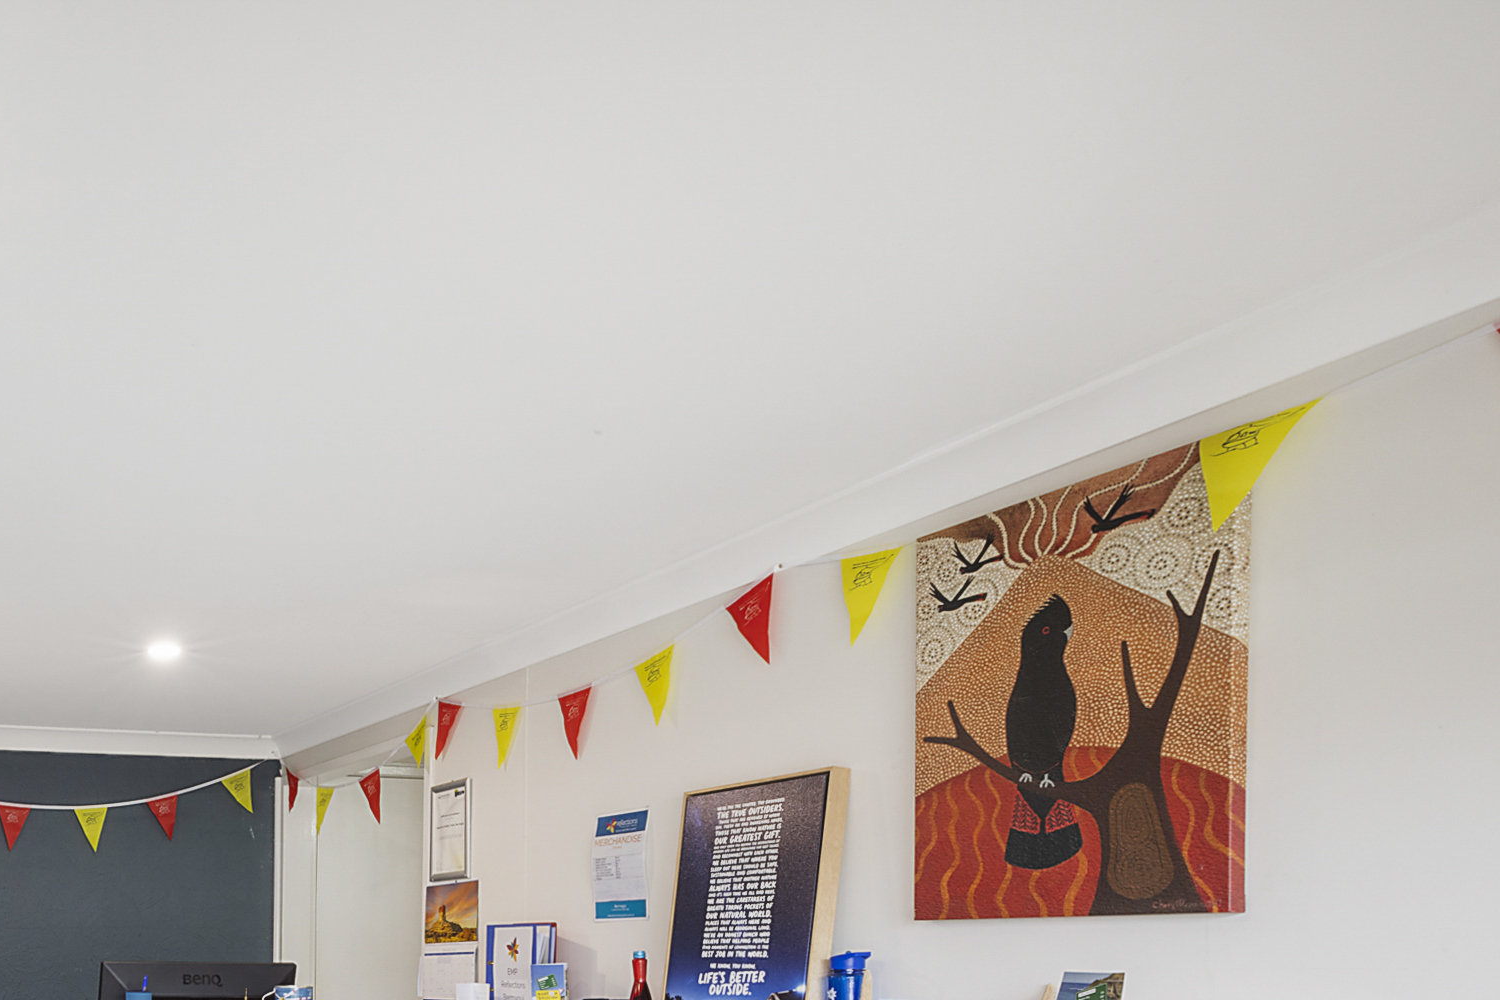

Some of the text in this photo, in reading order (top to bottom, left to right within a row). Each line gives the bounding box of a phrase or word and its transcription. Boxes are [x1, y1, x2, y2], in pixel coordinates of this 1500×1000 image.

[716, 810, 729, 820] THE
[748, 802, 783, 815] OUTSIDERS.
[594, 833, 643, 847] MERCHANDISE
[713, 835, 728, 845] OUR
[729, 831, 762, 843] GREATEST
[763, 829, 781, 839] GIFT.
[708, 880, 776, 892] ALWAYS HAS OUR BACK
[719, 910, 746, 919] NATURAL
[748, 909, 772, 917] WORLD.
[747, 949, 768, 957] WORLD.
[698, 970, 766, 984] LIFE'S BETTER
[709, 983, 752, 996] OUTSIDE.
